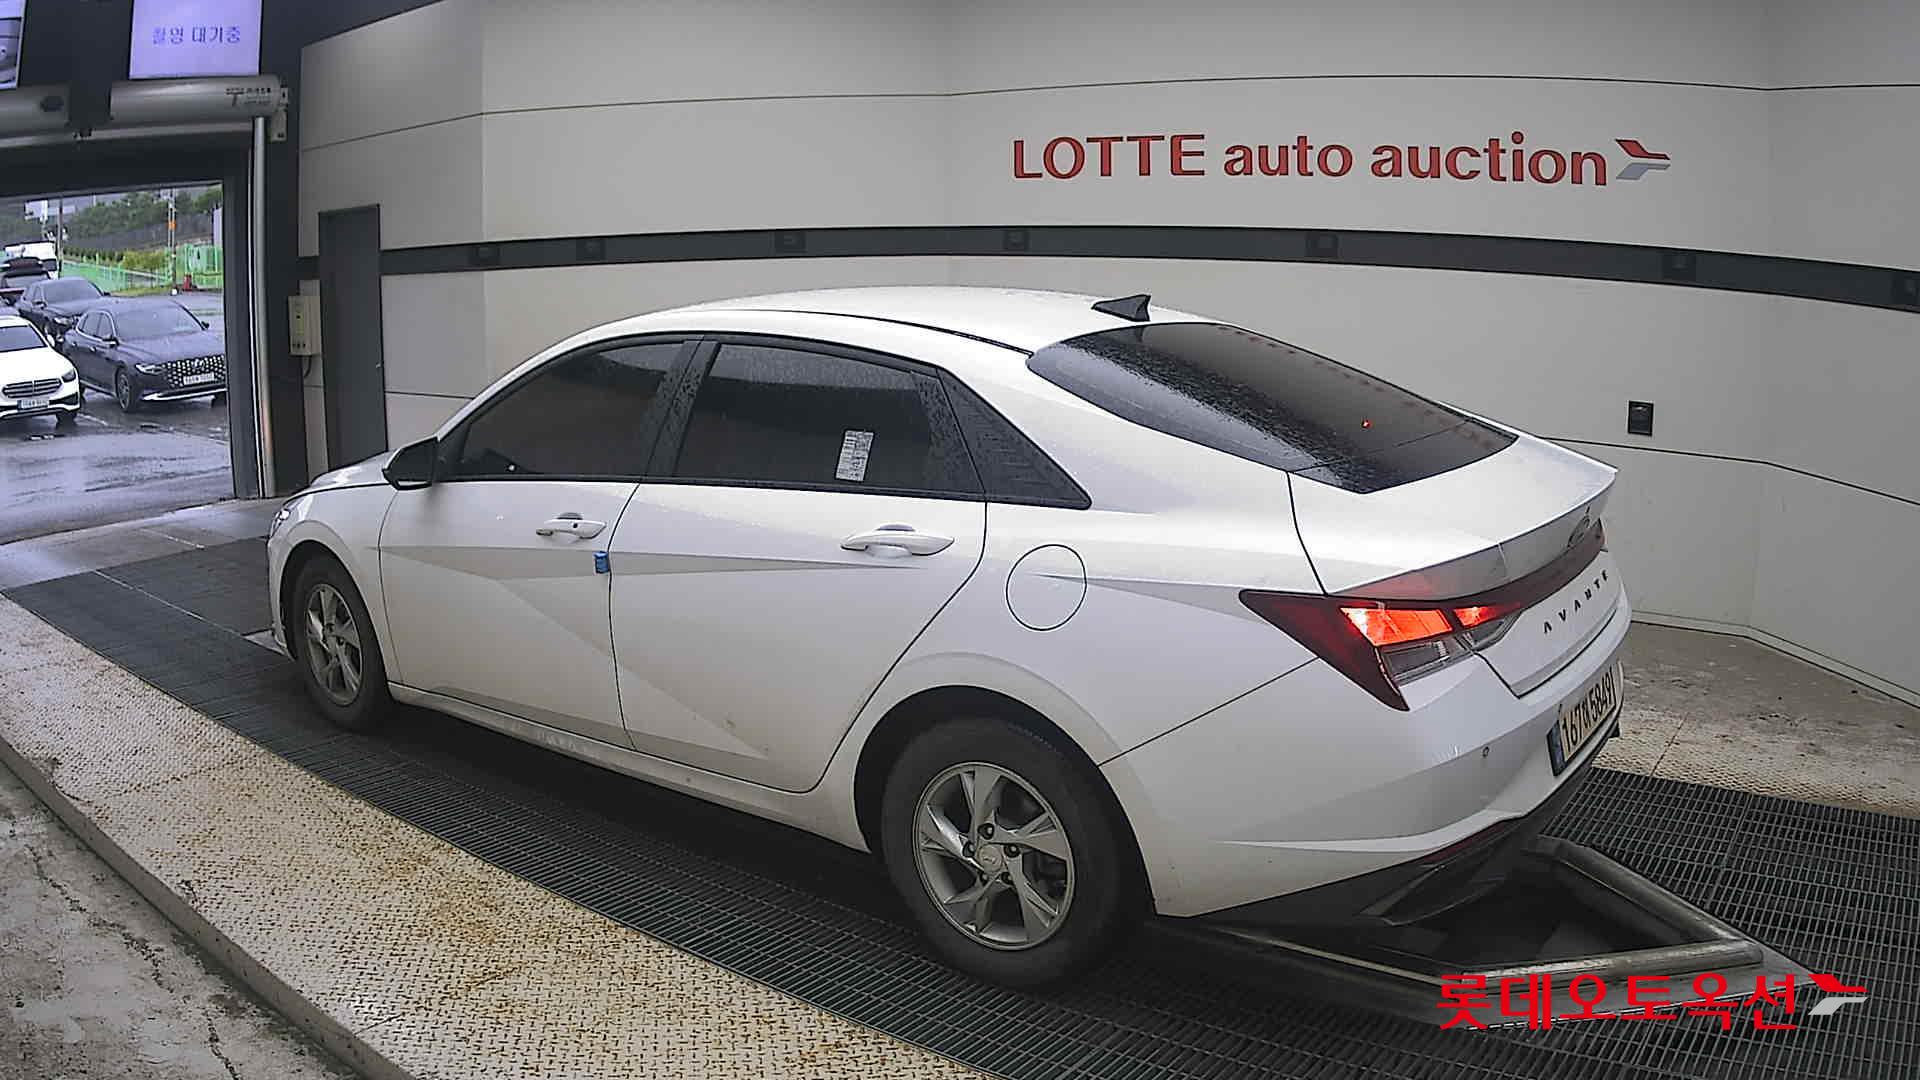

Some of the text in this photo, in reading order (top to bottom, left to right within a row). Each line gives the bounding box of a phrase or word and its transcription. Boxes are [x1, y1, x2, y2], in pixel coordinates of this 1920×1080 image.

[191, 26, 241, 44] 대기중
[1013, 131, 1607, 186] LOTTE auto auction
[1543, 569, 1608, 634] AVANTE
